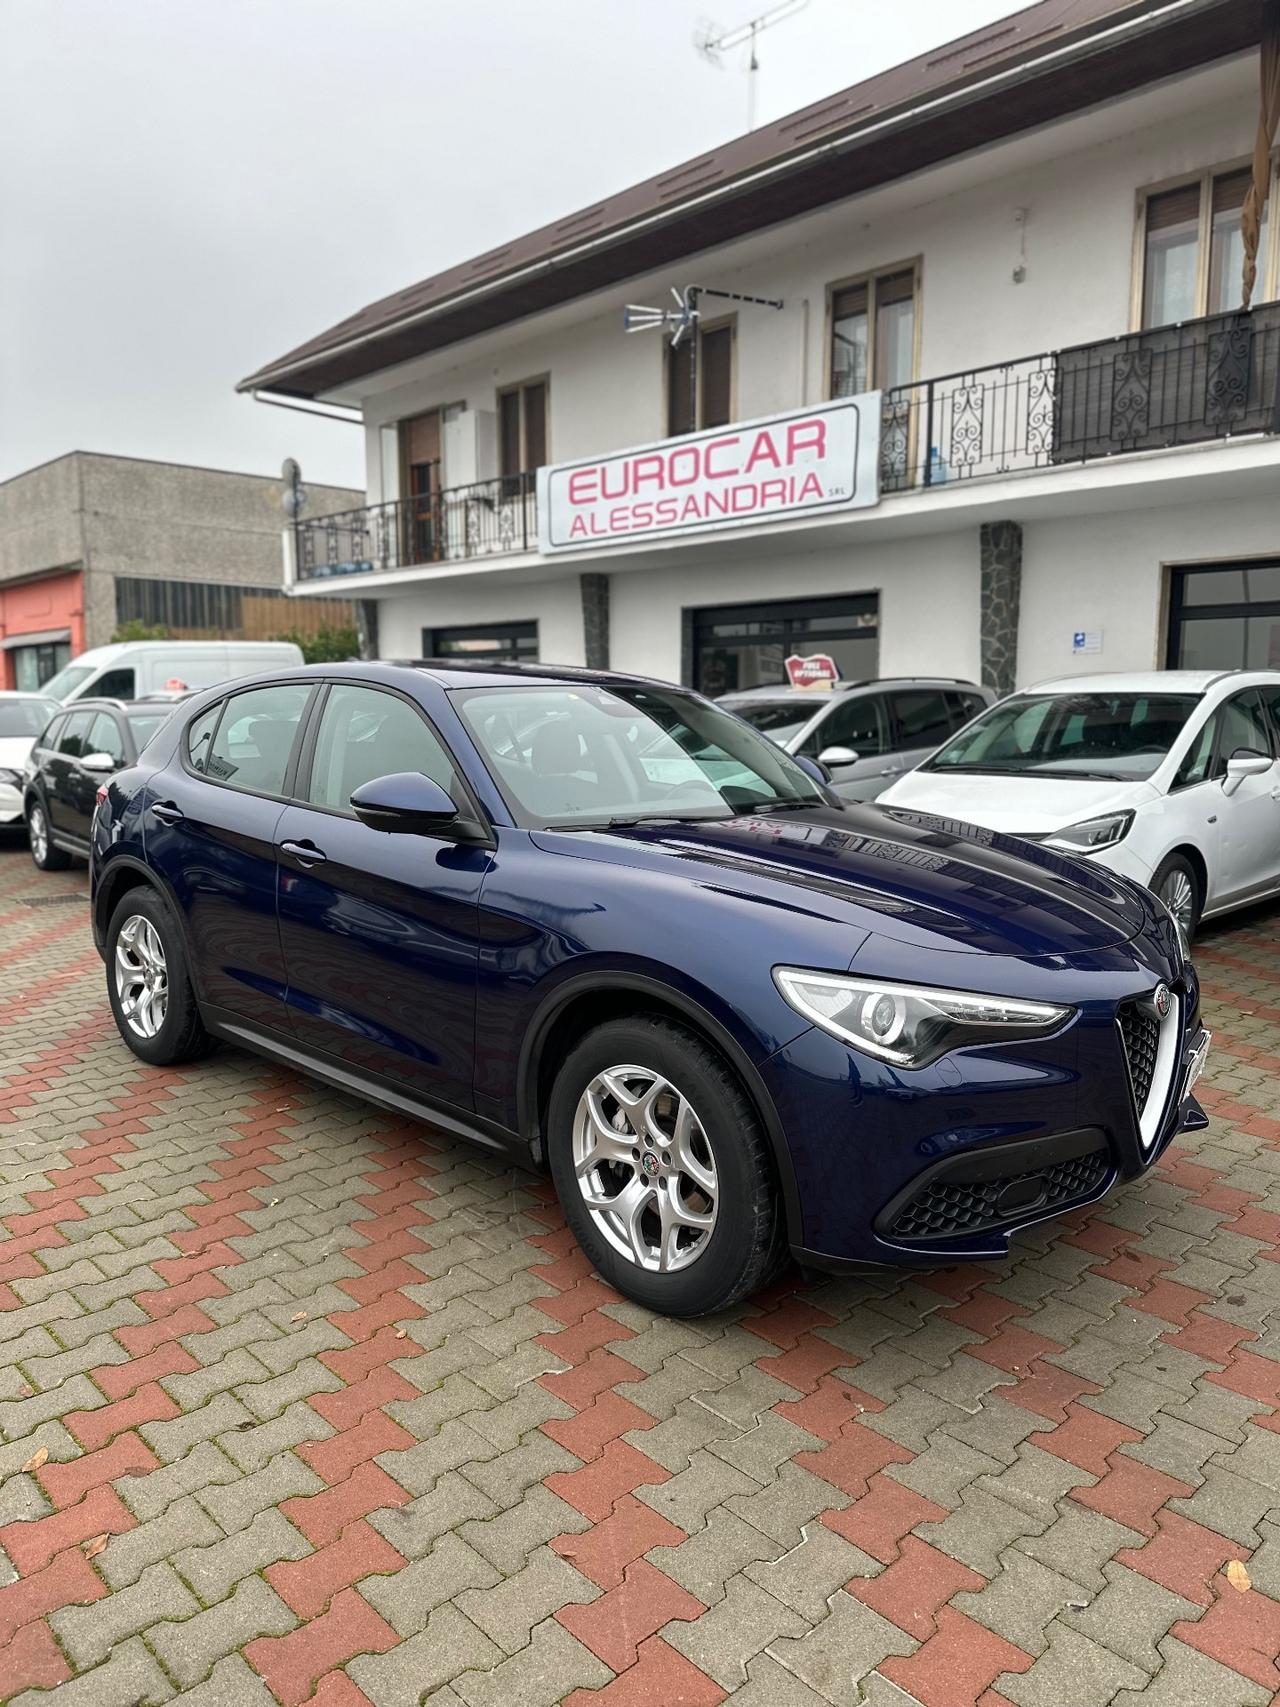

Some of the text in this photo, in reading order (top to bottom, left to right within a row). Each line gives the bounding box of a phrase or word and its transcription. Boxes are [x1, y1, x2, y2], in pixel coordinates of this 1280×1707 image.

[568, 419, 827, 506] EUROCAR
[569, 472, 846, 538] ALESSANDRIA SRL
